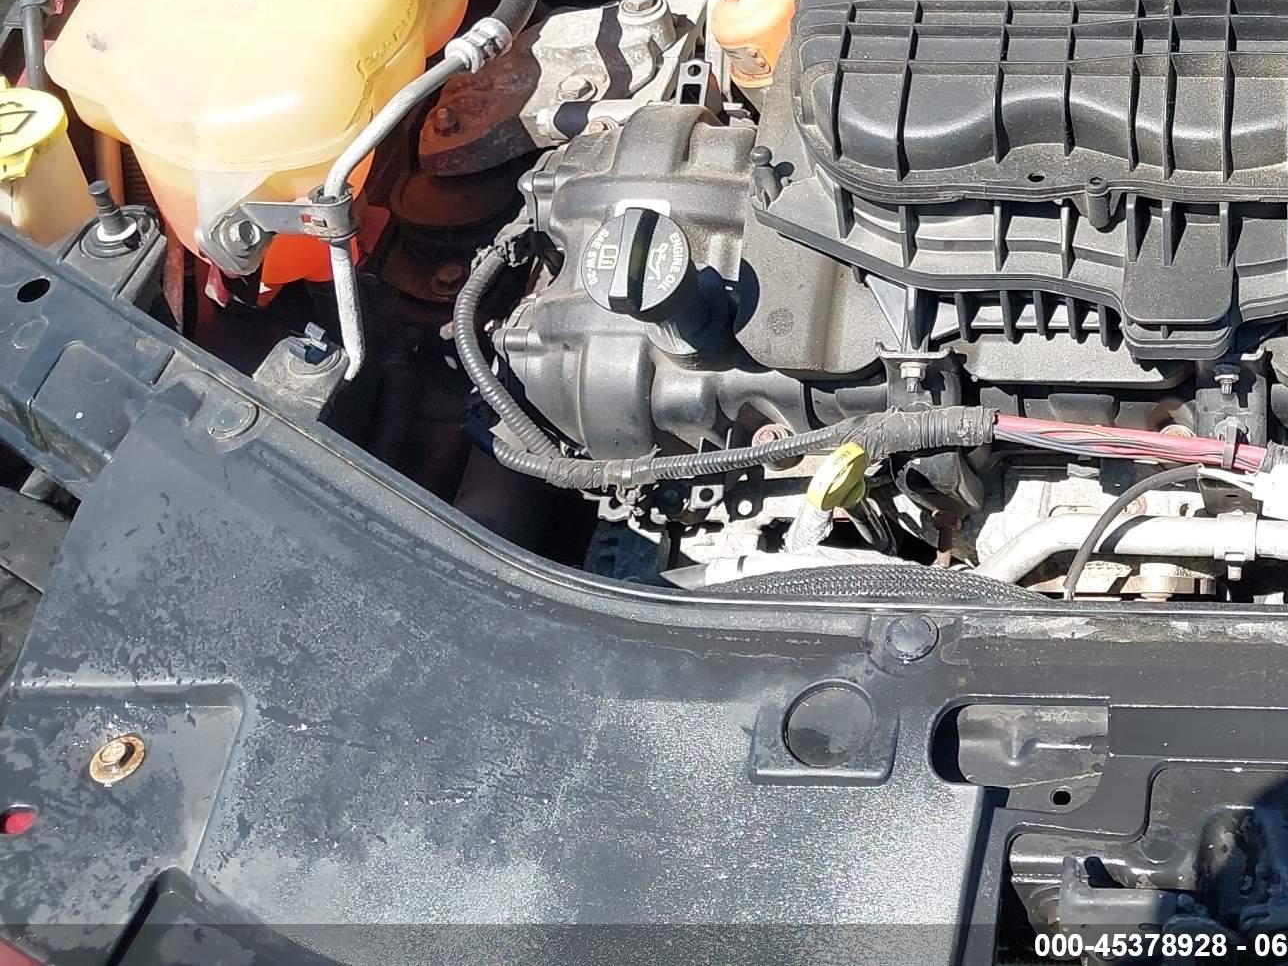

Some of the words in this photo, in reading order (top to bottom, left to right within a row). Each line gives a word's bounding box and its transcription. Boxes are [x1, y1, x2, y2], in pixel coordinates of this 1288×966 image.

[591, 229, 609, 250] SAE
[670, 233, 684, 274] ENGINE
[586, 251, 599, 286] 5W-20
[657, 275, 676, 292] OIL
